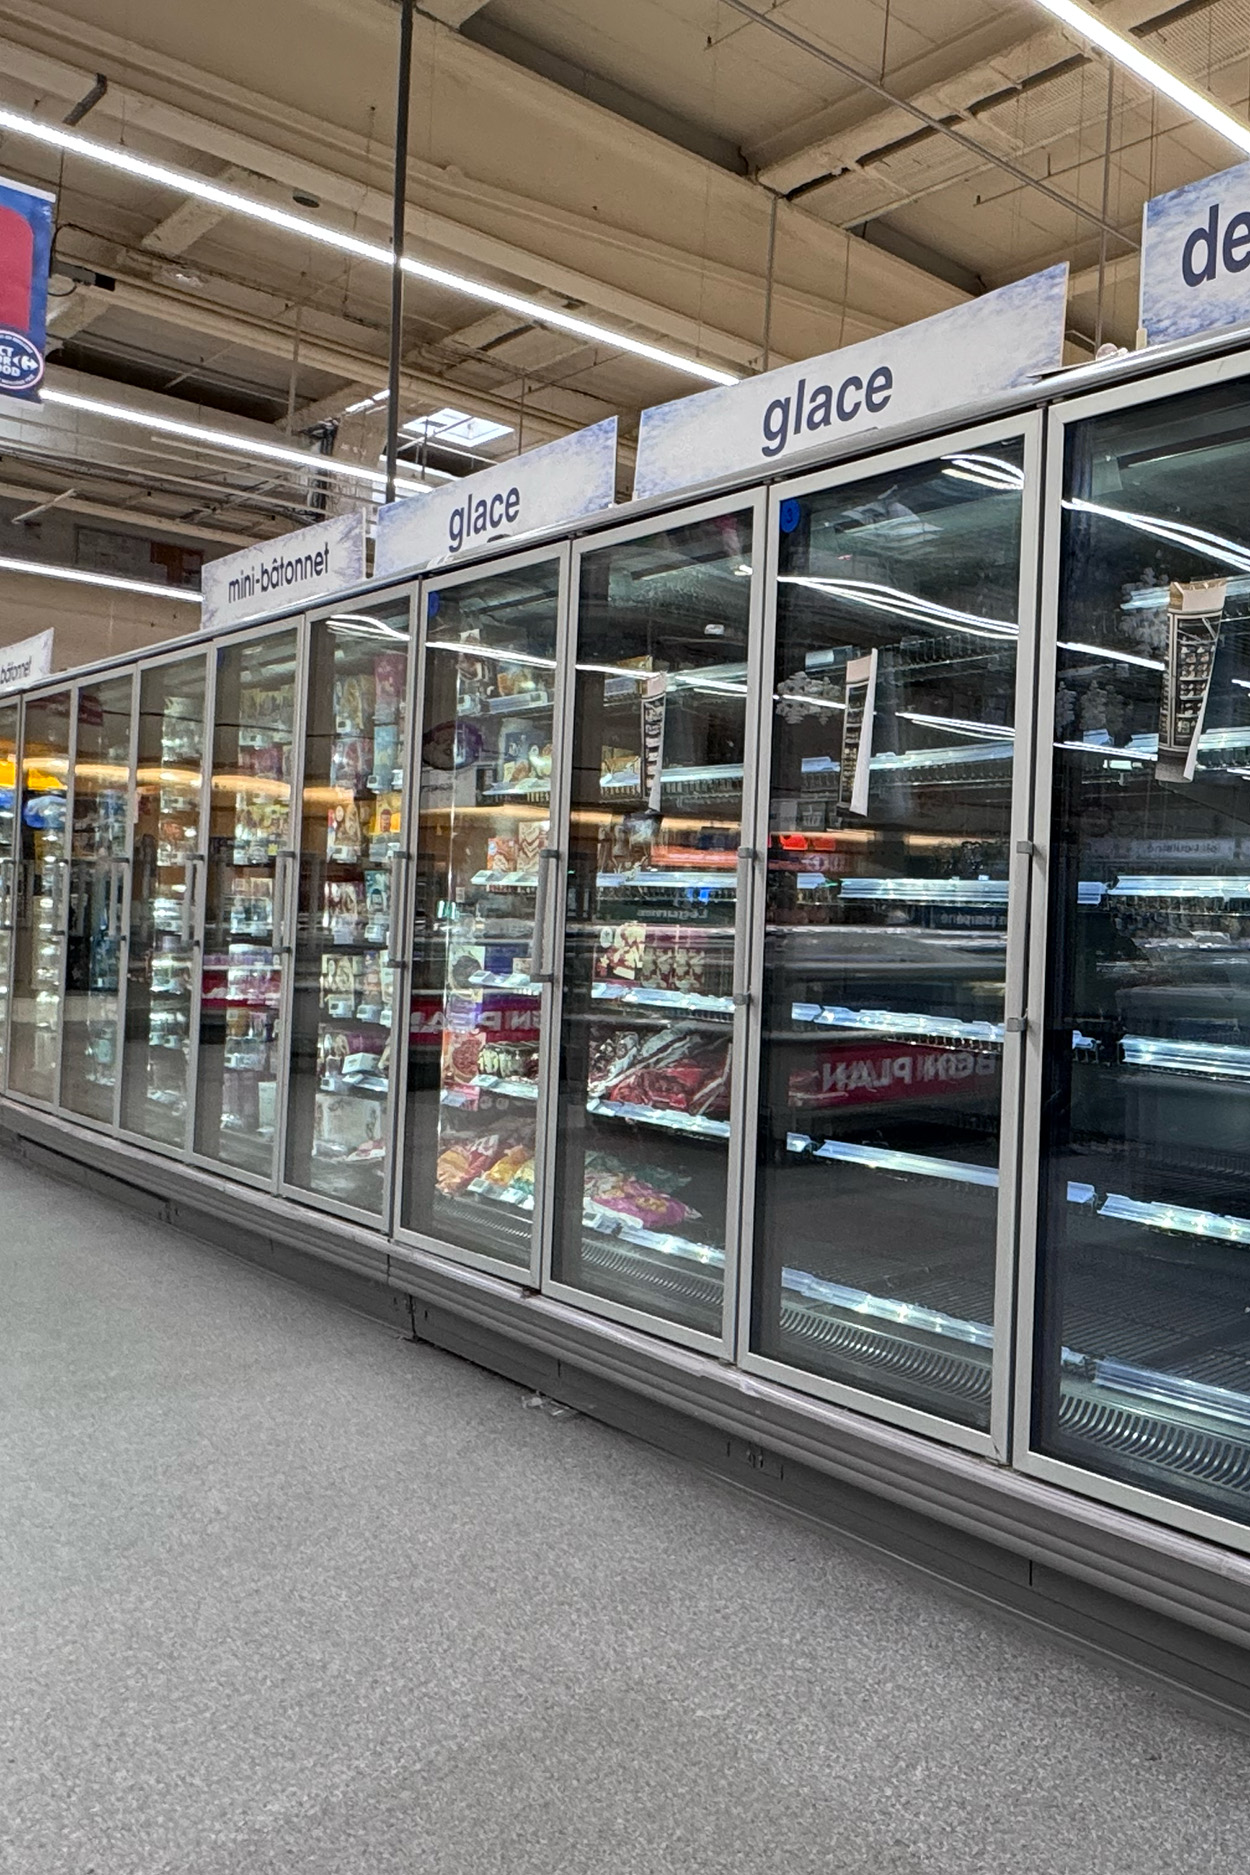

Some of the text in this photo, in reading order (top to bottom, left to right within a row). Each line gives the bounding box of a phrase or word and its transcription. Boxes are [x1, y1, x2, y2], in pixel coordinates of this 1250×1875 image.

[761, 366, 893, 457] glace
[448, 486, 521, 553] glace
[228, 541, 330, 604] mini-bâtonnet
